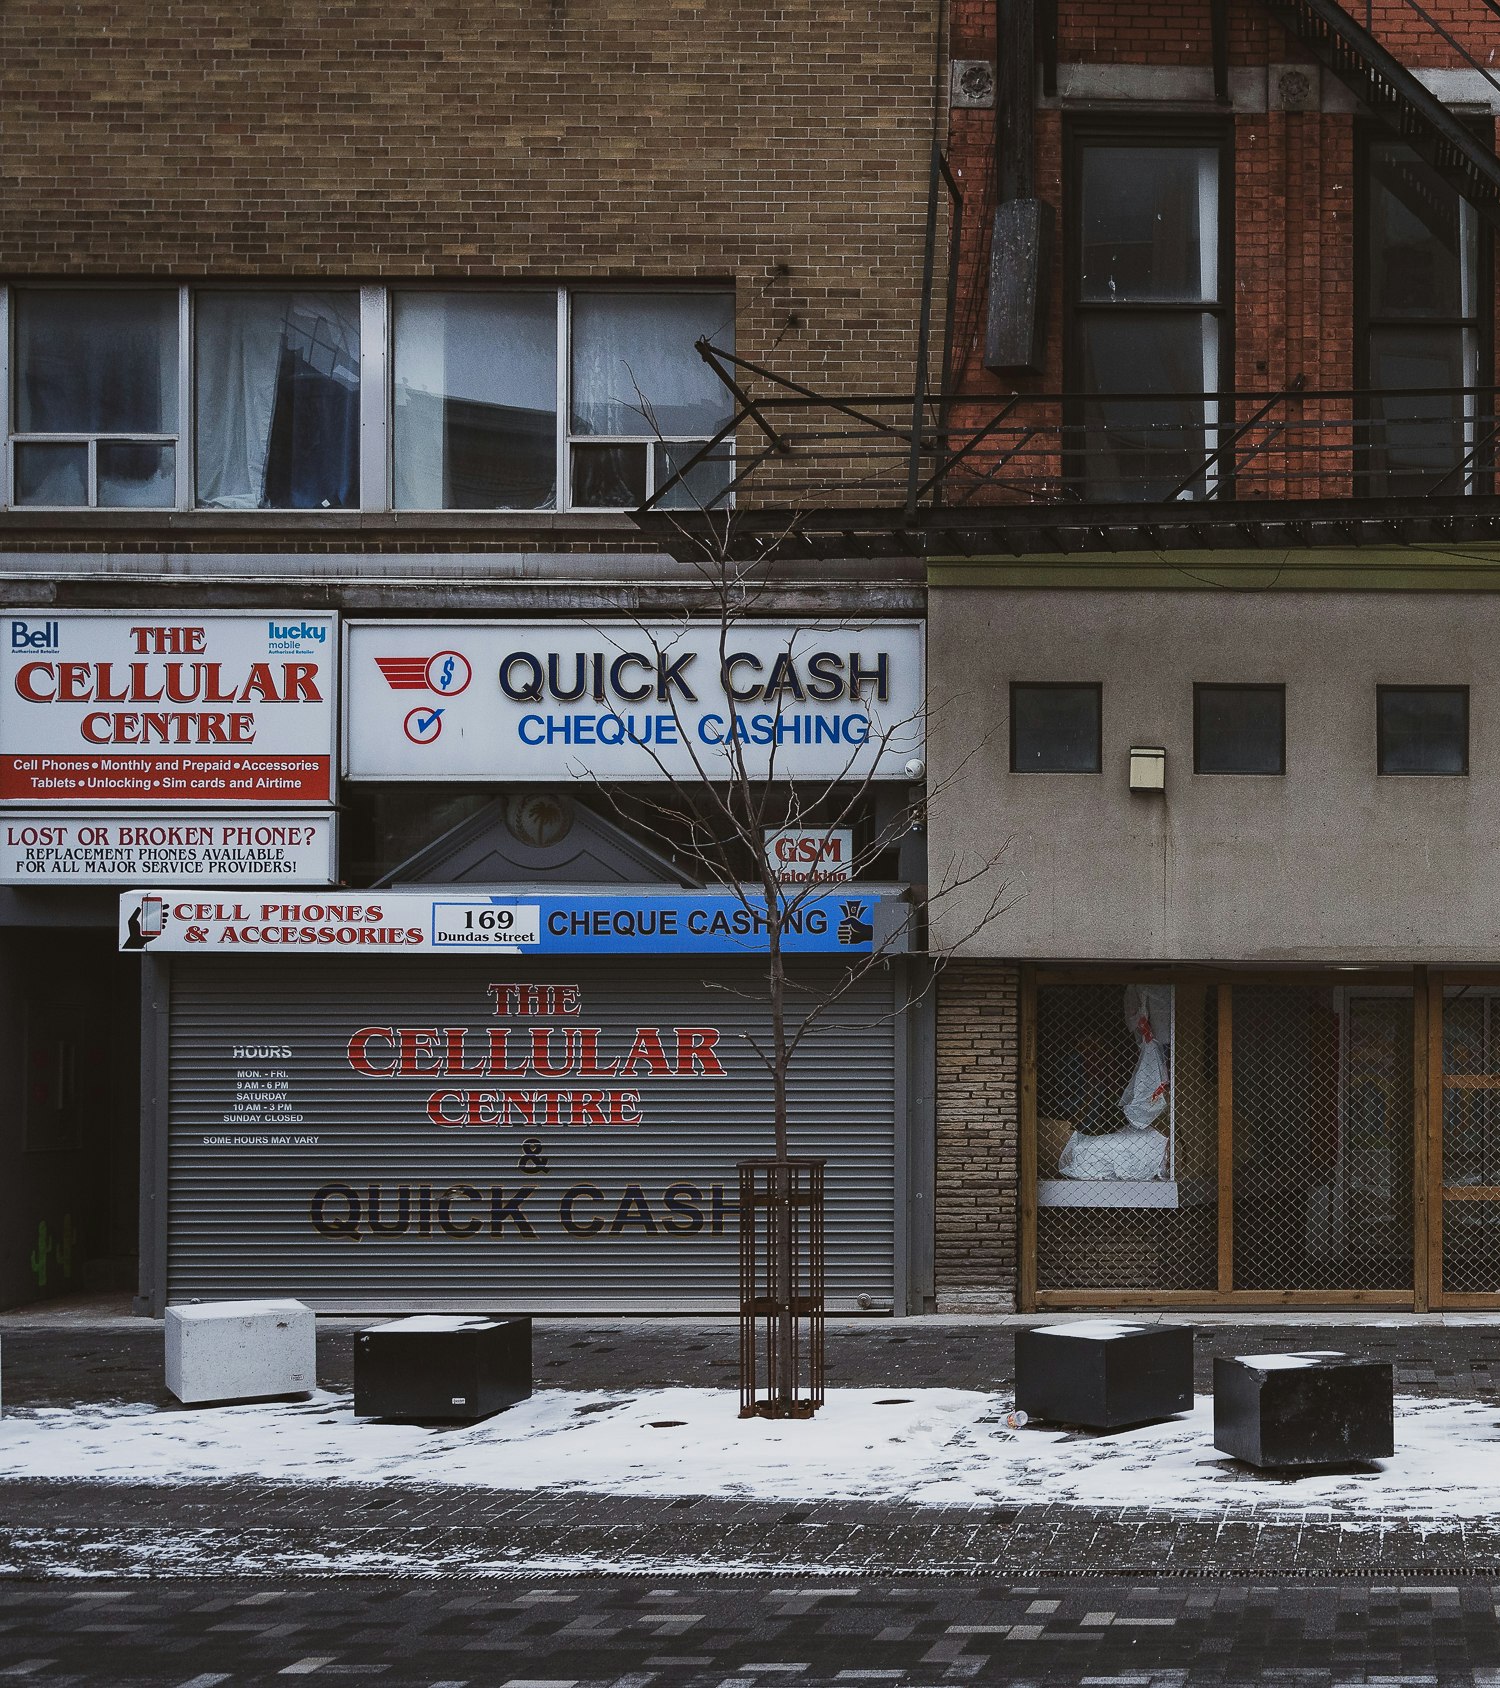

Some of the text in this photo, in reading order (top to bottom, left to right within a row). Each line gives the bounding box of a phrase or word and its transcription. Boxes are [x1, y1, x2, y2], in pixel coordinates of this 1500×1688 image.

[11, 621, 59, 648] Bell
[129, 626, 208, 655] THE
[268, 622, 326, 643] lucky
[268, 641, 301, 649] mobile
[15, 661, 324, 704] CELLULAR
[498, 650, 889, 703] QUICK CASH
[81, 711, 257, 745] CENTRE
[518, 713, 871, 745] CHEQUE CASHING
[13, 759, 319, 774] Cell Phones Monthly and Prepaid Accessories
[31, 777, 302, 791] Tablets Unlocking Sim cards and Airtime
[7, 827, 316, 847] LOST OR BROKEN PHONE?
[25, 848, 284, 861] REPLACEMENT PHONES AVAILABLE
[774, 838, 842, 863] GSM
[16, 861, 297, 873] FOR ALL MAJOR SERVICE PROVIDERS!
[172, 903, 384, 922] CELL PHONES
[462, 910, 515, 930] 169
[547, 909, 829, 937] CHEQUE CASHNG
[184, 926, 425, 946] & ACCESSORIES
[437, 930, 535, 943] Dundas Street
[487, 983, 582, 1017] THE
[232, 1045, 293, 1059] HOURS
[346, 1026, 728, 1078] CELLULAR
[237, 1070, 262, 1078] MON.
[270, 1070, 289, 1078] FRI.
[236, 1081, 243, 1090] 9
[244, 1081, 259, 1090] AM
[266, 1081, 273, 1090] 6
[274, 1081, 289, 1090] PM
[236, 1092, 288, 1101] SATURDAY
[233, 1103, 244, 1111] 10
[246, 1103, 261, 1111] AM
[269, 1103, 275, 1111] 3
[277, 1103, 293, 1111] PM
[426, 1088, 643, 1128] CENTRE
[223, 1114, 304, 1122] SUNDAY CLOSED
[203, 1136, 320, 1144] SOME HOURS MAY VARY
[517, 1138, 550, 1174] &
[309, 1183, 541, 1243] QUICK
